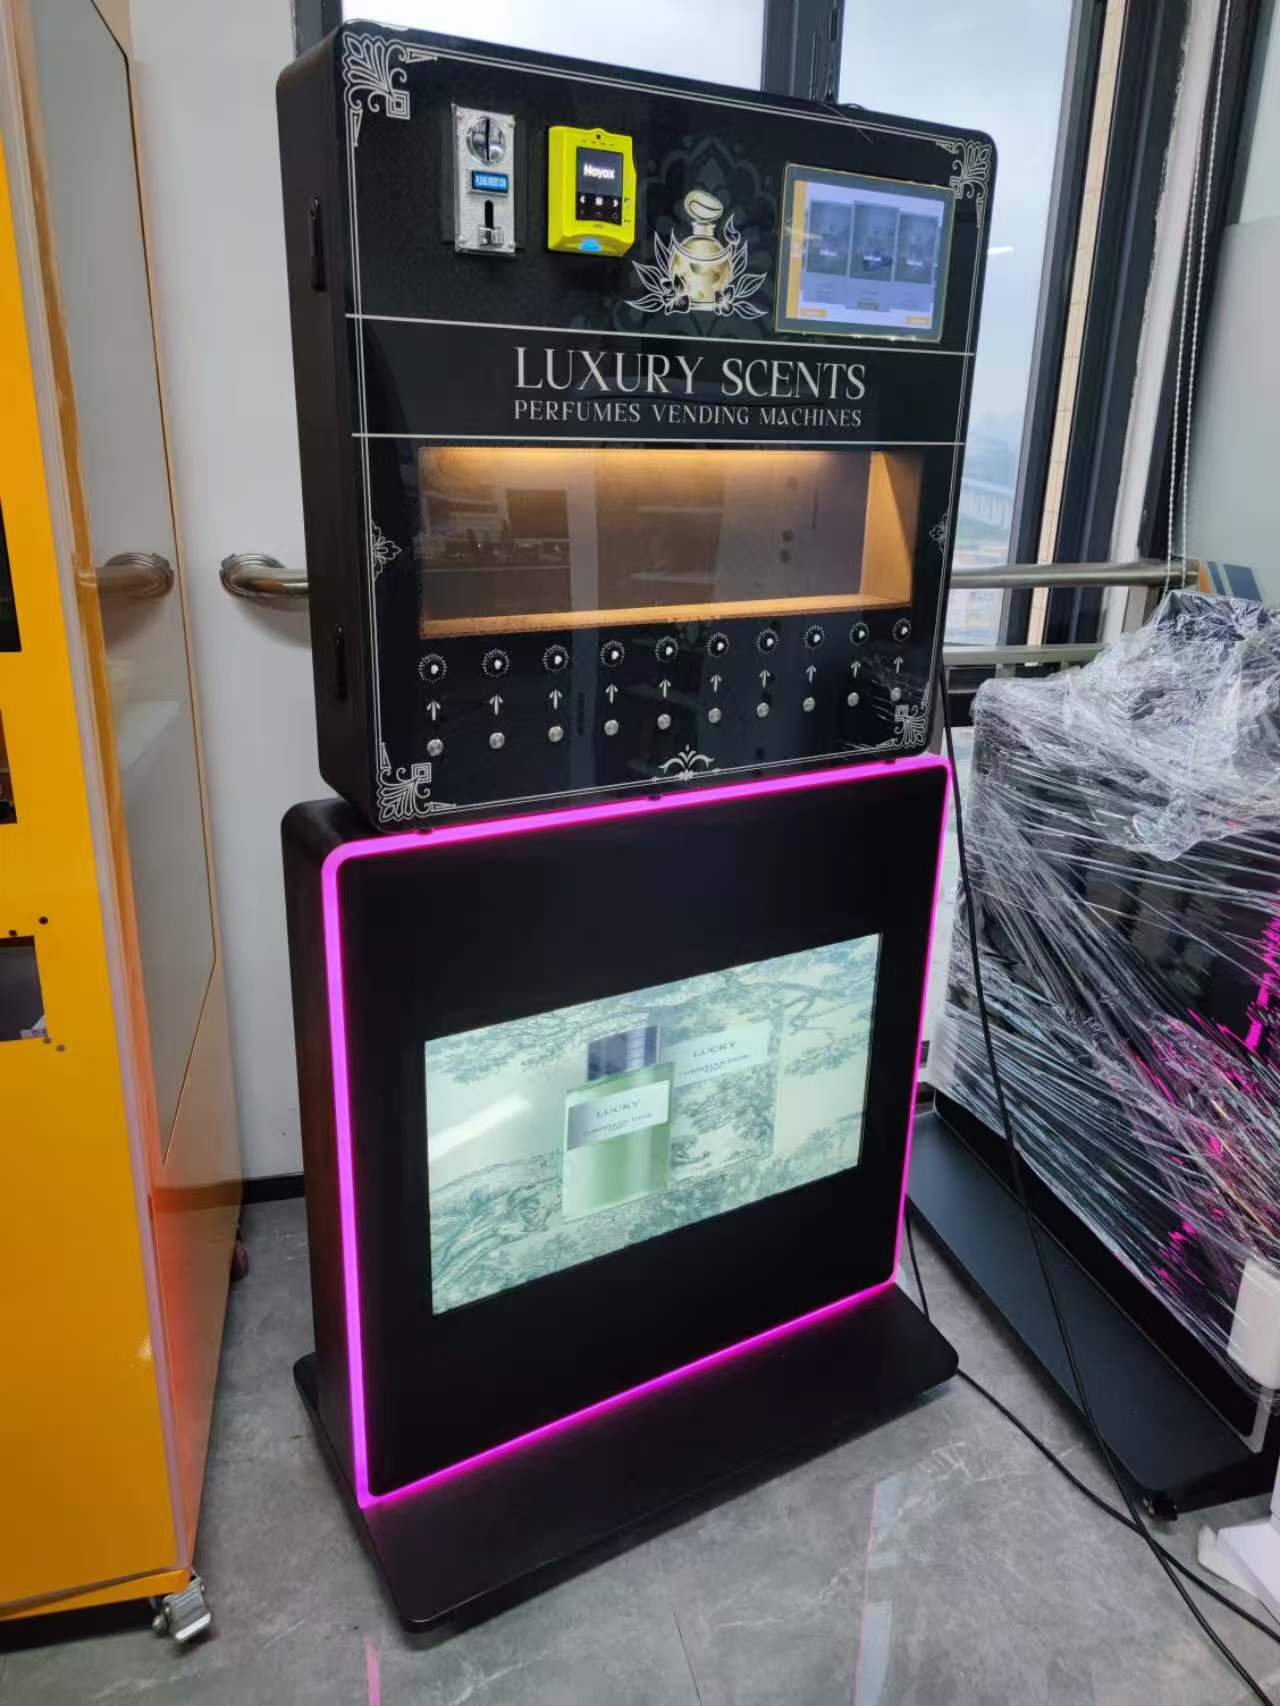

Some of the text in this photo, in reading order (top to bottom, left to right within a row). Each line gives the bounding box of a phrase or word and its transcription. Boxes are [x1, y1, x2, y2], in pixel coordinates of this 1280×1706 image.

[514, 346, 867, 400] LUXURY SCENTS
[514, 400, 863, 428] PERFUMES VENDING MACHINES
[693, 1040, 737, 1058] LUCKY
[596, 1099, 641, 1118] LUCKY
